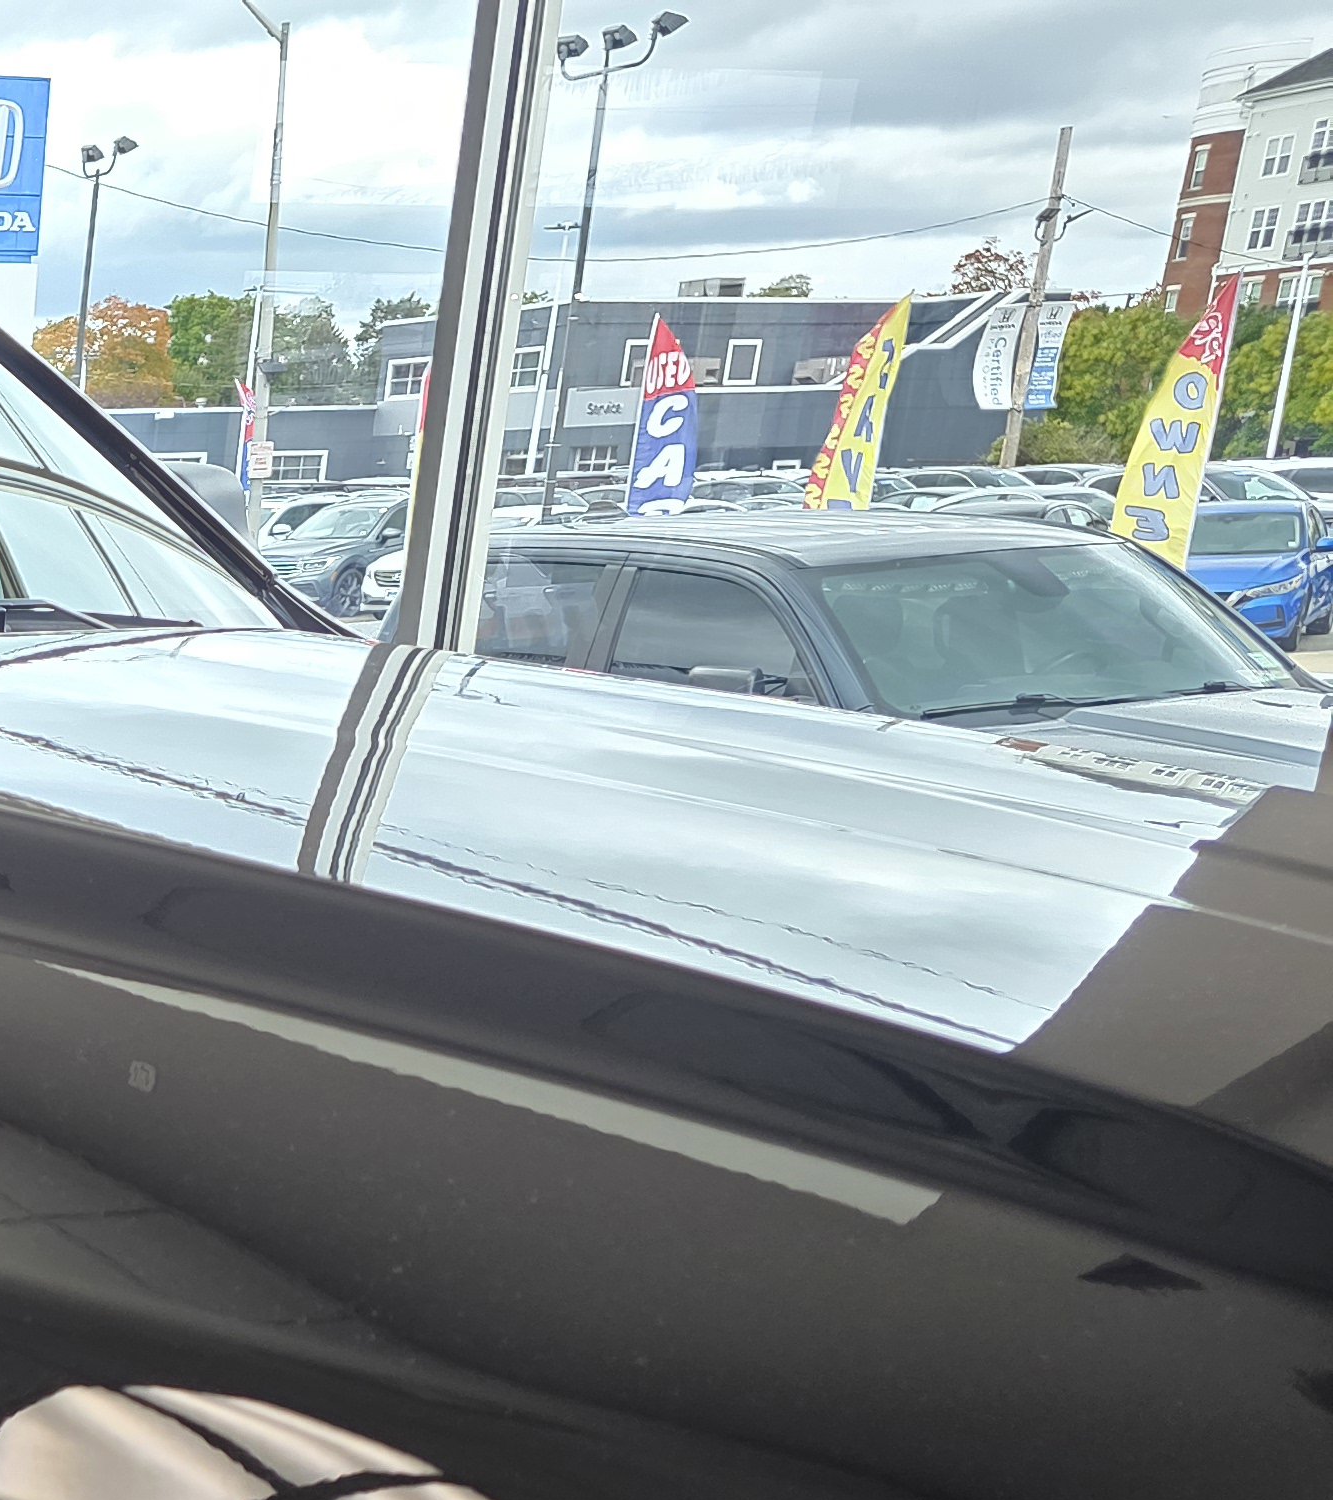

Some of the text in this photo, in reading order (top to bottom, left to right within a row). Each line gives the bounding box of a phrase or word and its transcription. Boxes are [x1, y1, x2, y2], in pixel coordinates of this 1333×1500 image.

[645, 351, 691, 394] USED
[990, 336, 1008, 405] Certified
[586, 401, 623, 416] Service
